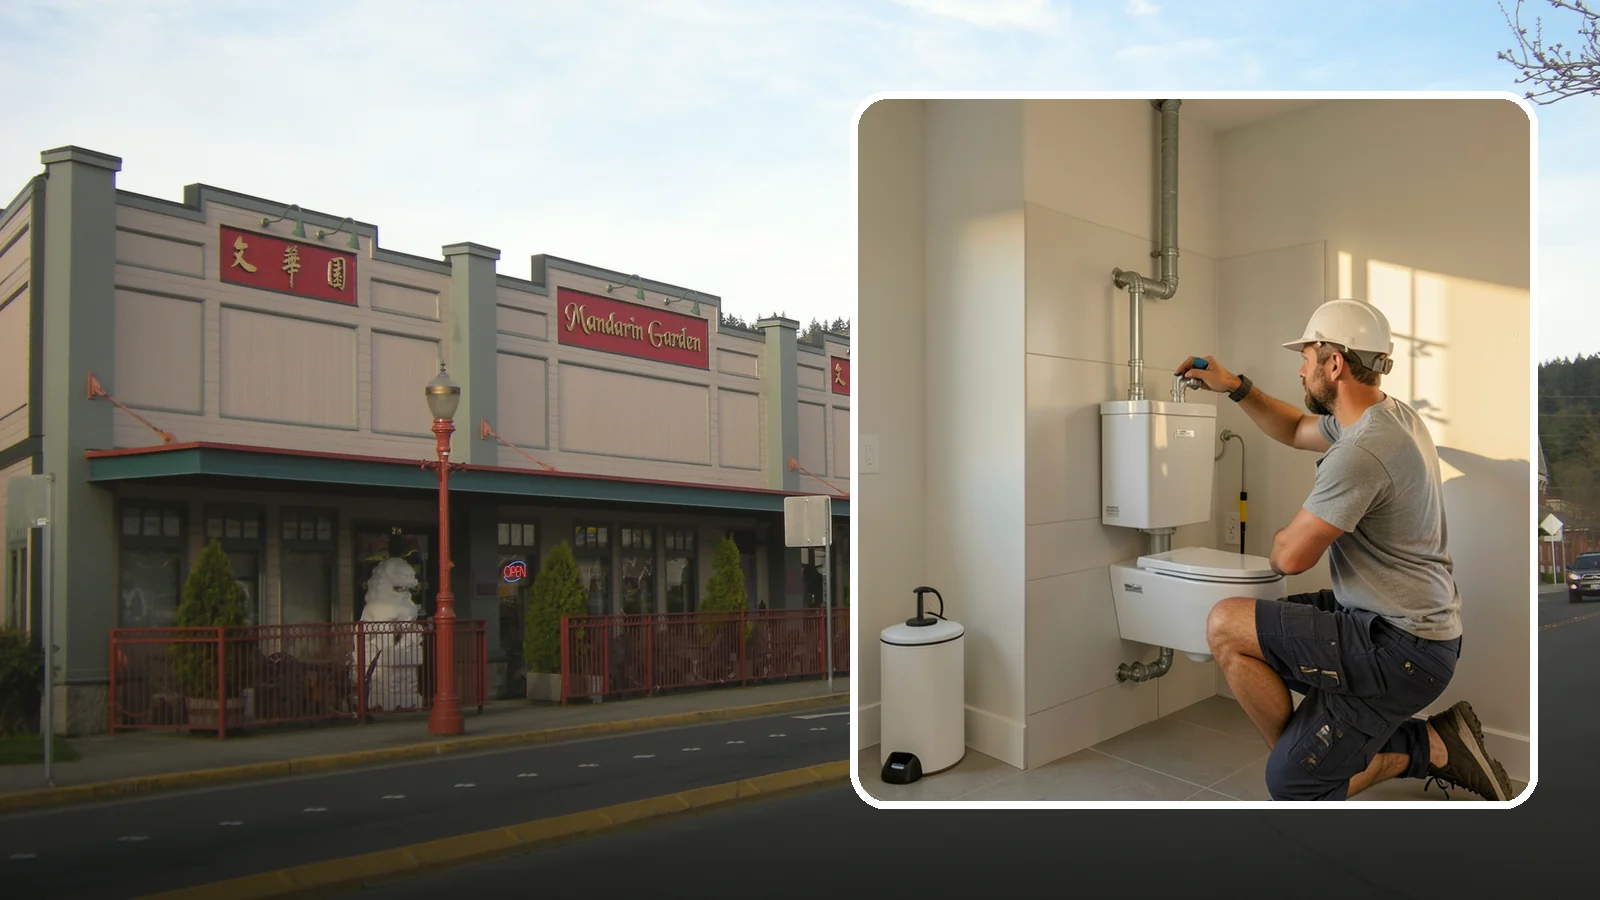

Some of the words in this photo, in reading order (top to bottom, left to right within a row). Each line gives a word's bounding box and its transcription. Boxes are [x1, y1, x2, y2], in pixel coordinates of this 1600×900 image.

[231, 236, 347, 291] 文華園
[564, 302, 644, 341] Mandarin
[648, 320, 702, 352] Garden
[503, 565, 527, 578] OPEN
